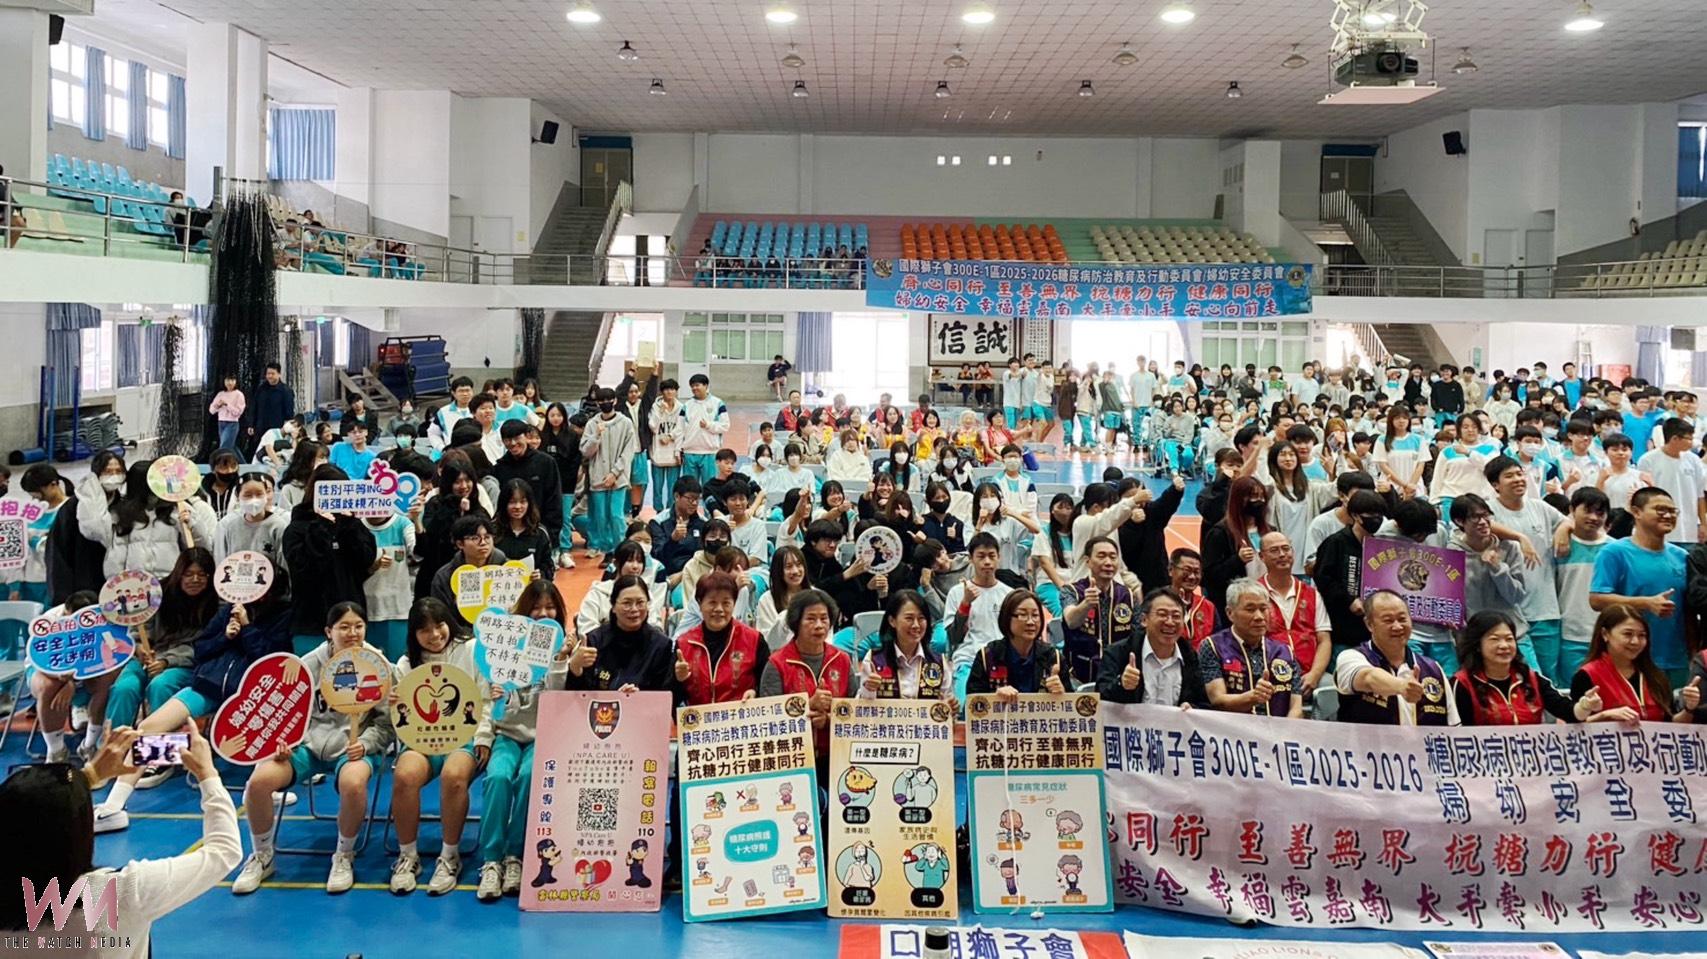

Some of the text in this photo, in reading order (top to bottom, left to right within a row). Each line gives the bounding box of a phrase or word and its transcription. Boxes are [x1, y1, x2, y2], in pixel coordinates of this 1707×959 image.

[902, 274, 985, 295] 齊心同行
[996, 281, 1081, 300] 至善無界
[1187, 282, 1274, 301] 健康同行
[895, 291, 969, 312] 婦幼安全
[978, 298, 1071, 317] 幸福雲嘉南
[1185, 300, 1280, 317] 安心向前走
[485, 567, 524, 578] 網路安全
[480, 615, 527, 634] 網路安全
[485, 633, 518, 646] 不自拍
[487, 648, 521, 664] 不持有
[496, 669, 529, 683] 不傳送
[228, 674, 276, 729] 婦幼安全
[703, 702, 783, 724] 國際獅子會300E-1區
[855, 706, 928, 719] 國際獅子會300E-1區
[682, 717, 807, 747] 糖尿病防治教育及行動委員會
[834, 724, 949, 740] 糖尿病防治教育及行動委員會
[686, 736, 805, 764] 齊心同行 至善無界
[975, 736, 1094, 753] 齊心同行 至善無界
[687, 753, 807, 780] 抗糖力行健康同行
[975, 753, 1095, 769] 抗糖力行健康同行
[1103, 725, 1424, 793] 國際獅子會300E-1區2025-2026
[640, 758, 657, 824] 報案電話
[536, 827, 552, 836] 113
[637, 828, 655, 837] 110
[1237, 820, 1416, 875] 至善無界
[1116, 858, 1188, 906] 安全
[1206, 866, 1394, 924] 幸福雲嘉南
[1630, 885, 1704, 929] 安心
